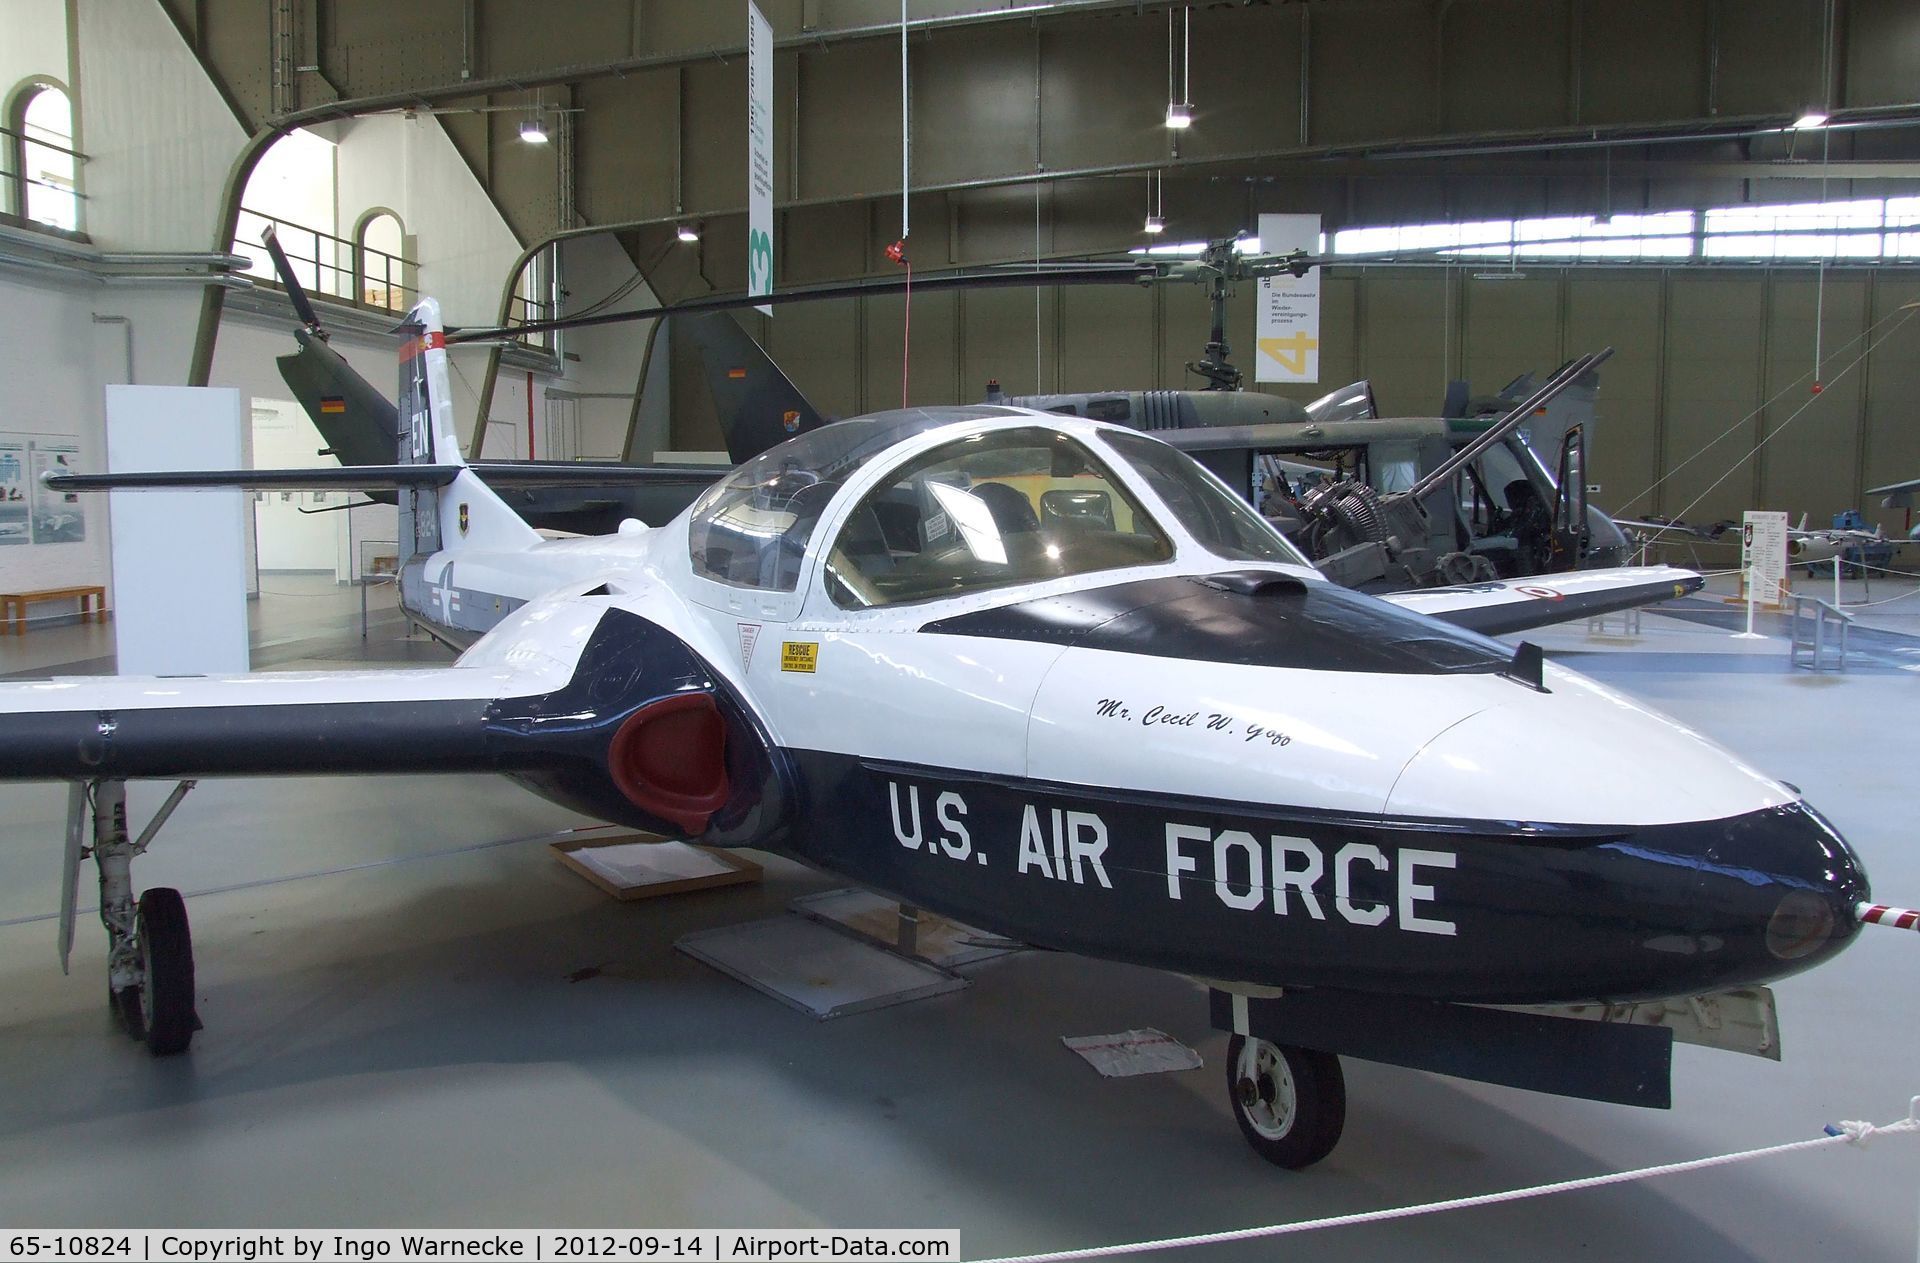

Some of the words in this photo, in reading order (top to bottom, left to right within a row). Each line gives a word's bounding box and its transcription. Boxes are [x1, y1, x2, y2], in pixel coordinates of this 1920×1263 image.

[750, 228, 772, 296] 3
[1258, 331, 1317, 375] 4
[412, 409, 429, 459] EN
[789, 644, 810, 656] RESCUE
[1096, 698, 1132, 721] Mr.
[1142, 705, 1199, 727] Cecil
[1206, 714, 1233, 735] W.
[889, 781, 988, 867] U.S.
[1018, 804, 1114, 890] AIR
[1166, 822, 1457, 937] FORCE
